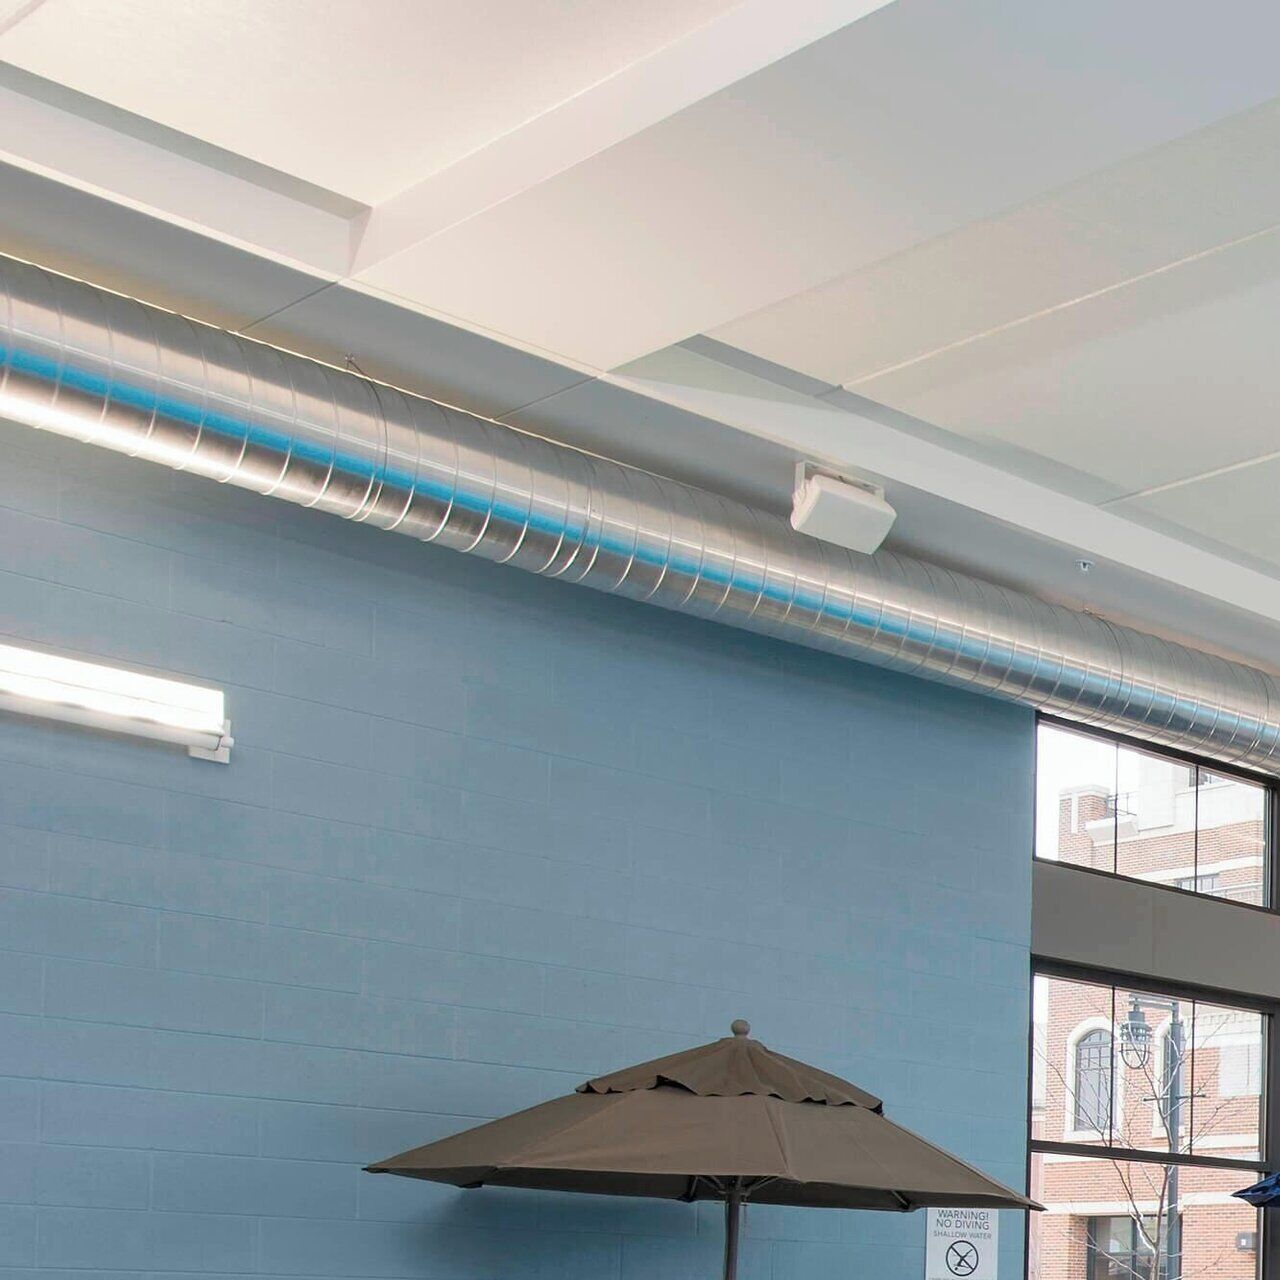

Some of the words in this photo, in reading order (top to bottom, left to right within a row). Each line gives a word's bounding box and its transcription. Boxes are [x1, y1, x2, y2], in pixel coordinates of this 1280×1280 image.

[937, 1209, 989, 1221] WARNING!
[936, 1218, 952, 1228] NO
[955, 1219, 990, 1230] DIVING
[933, 1230, 968, 1239] SHALLOW
[969, 1231, 992, 1239] WATER
